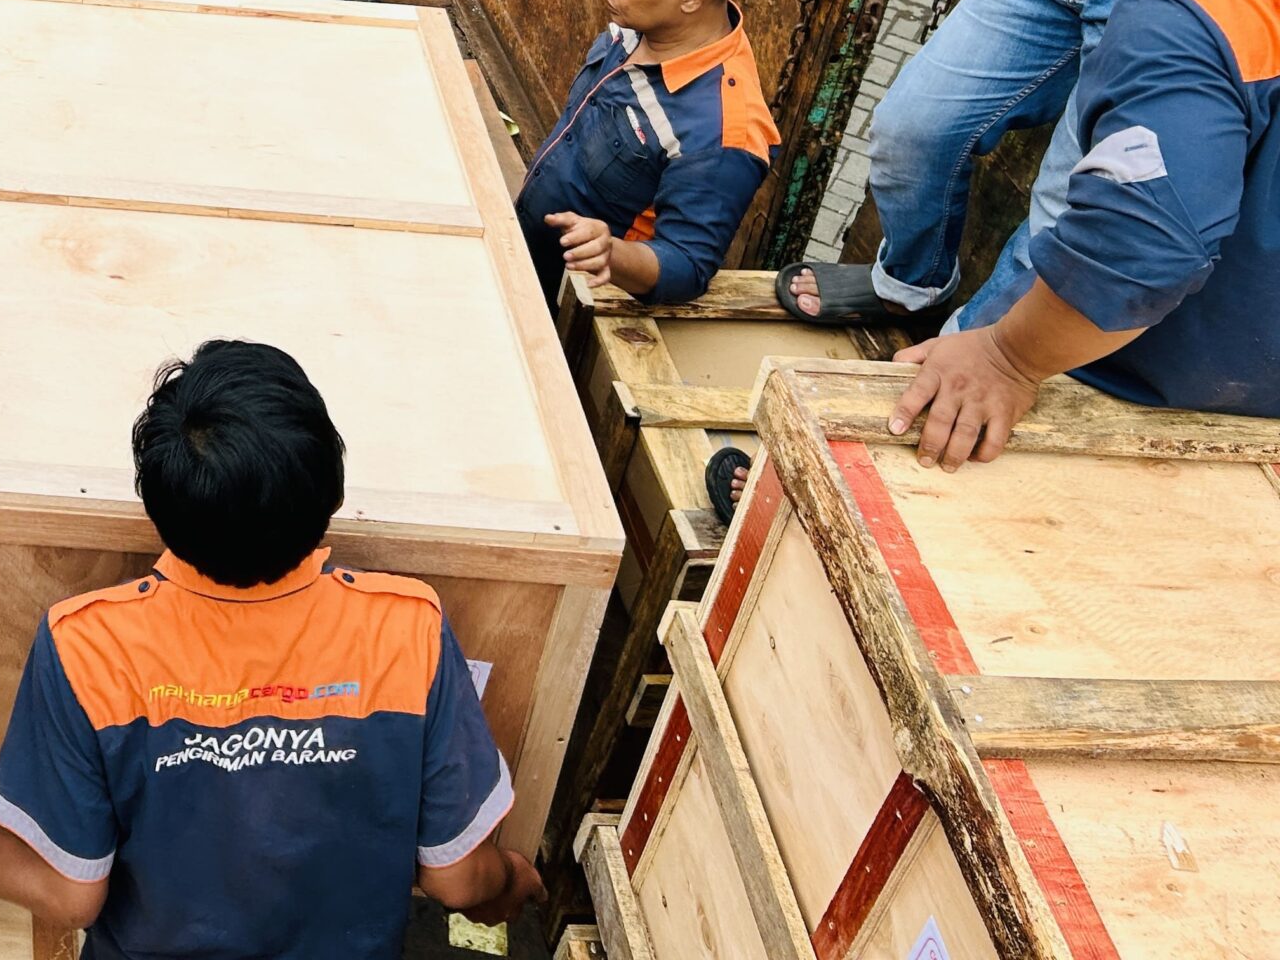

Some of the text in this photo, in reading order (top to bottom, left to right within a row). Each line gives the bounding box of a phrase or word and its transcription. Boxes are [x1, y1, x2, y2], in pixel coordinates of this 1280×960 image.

[148, 681, 360, 709] makharyacargo.com
[184, 727, 325, 756] JAGONYA
[155, 747, 357, 772] PENGIRIMAN BARANG
